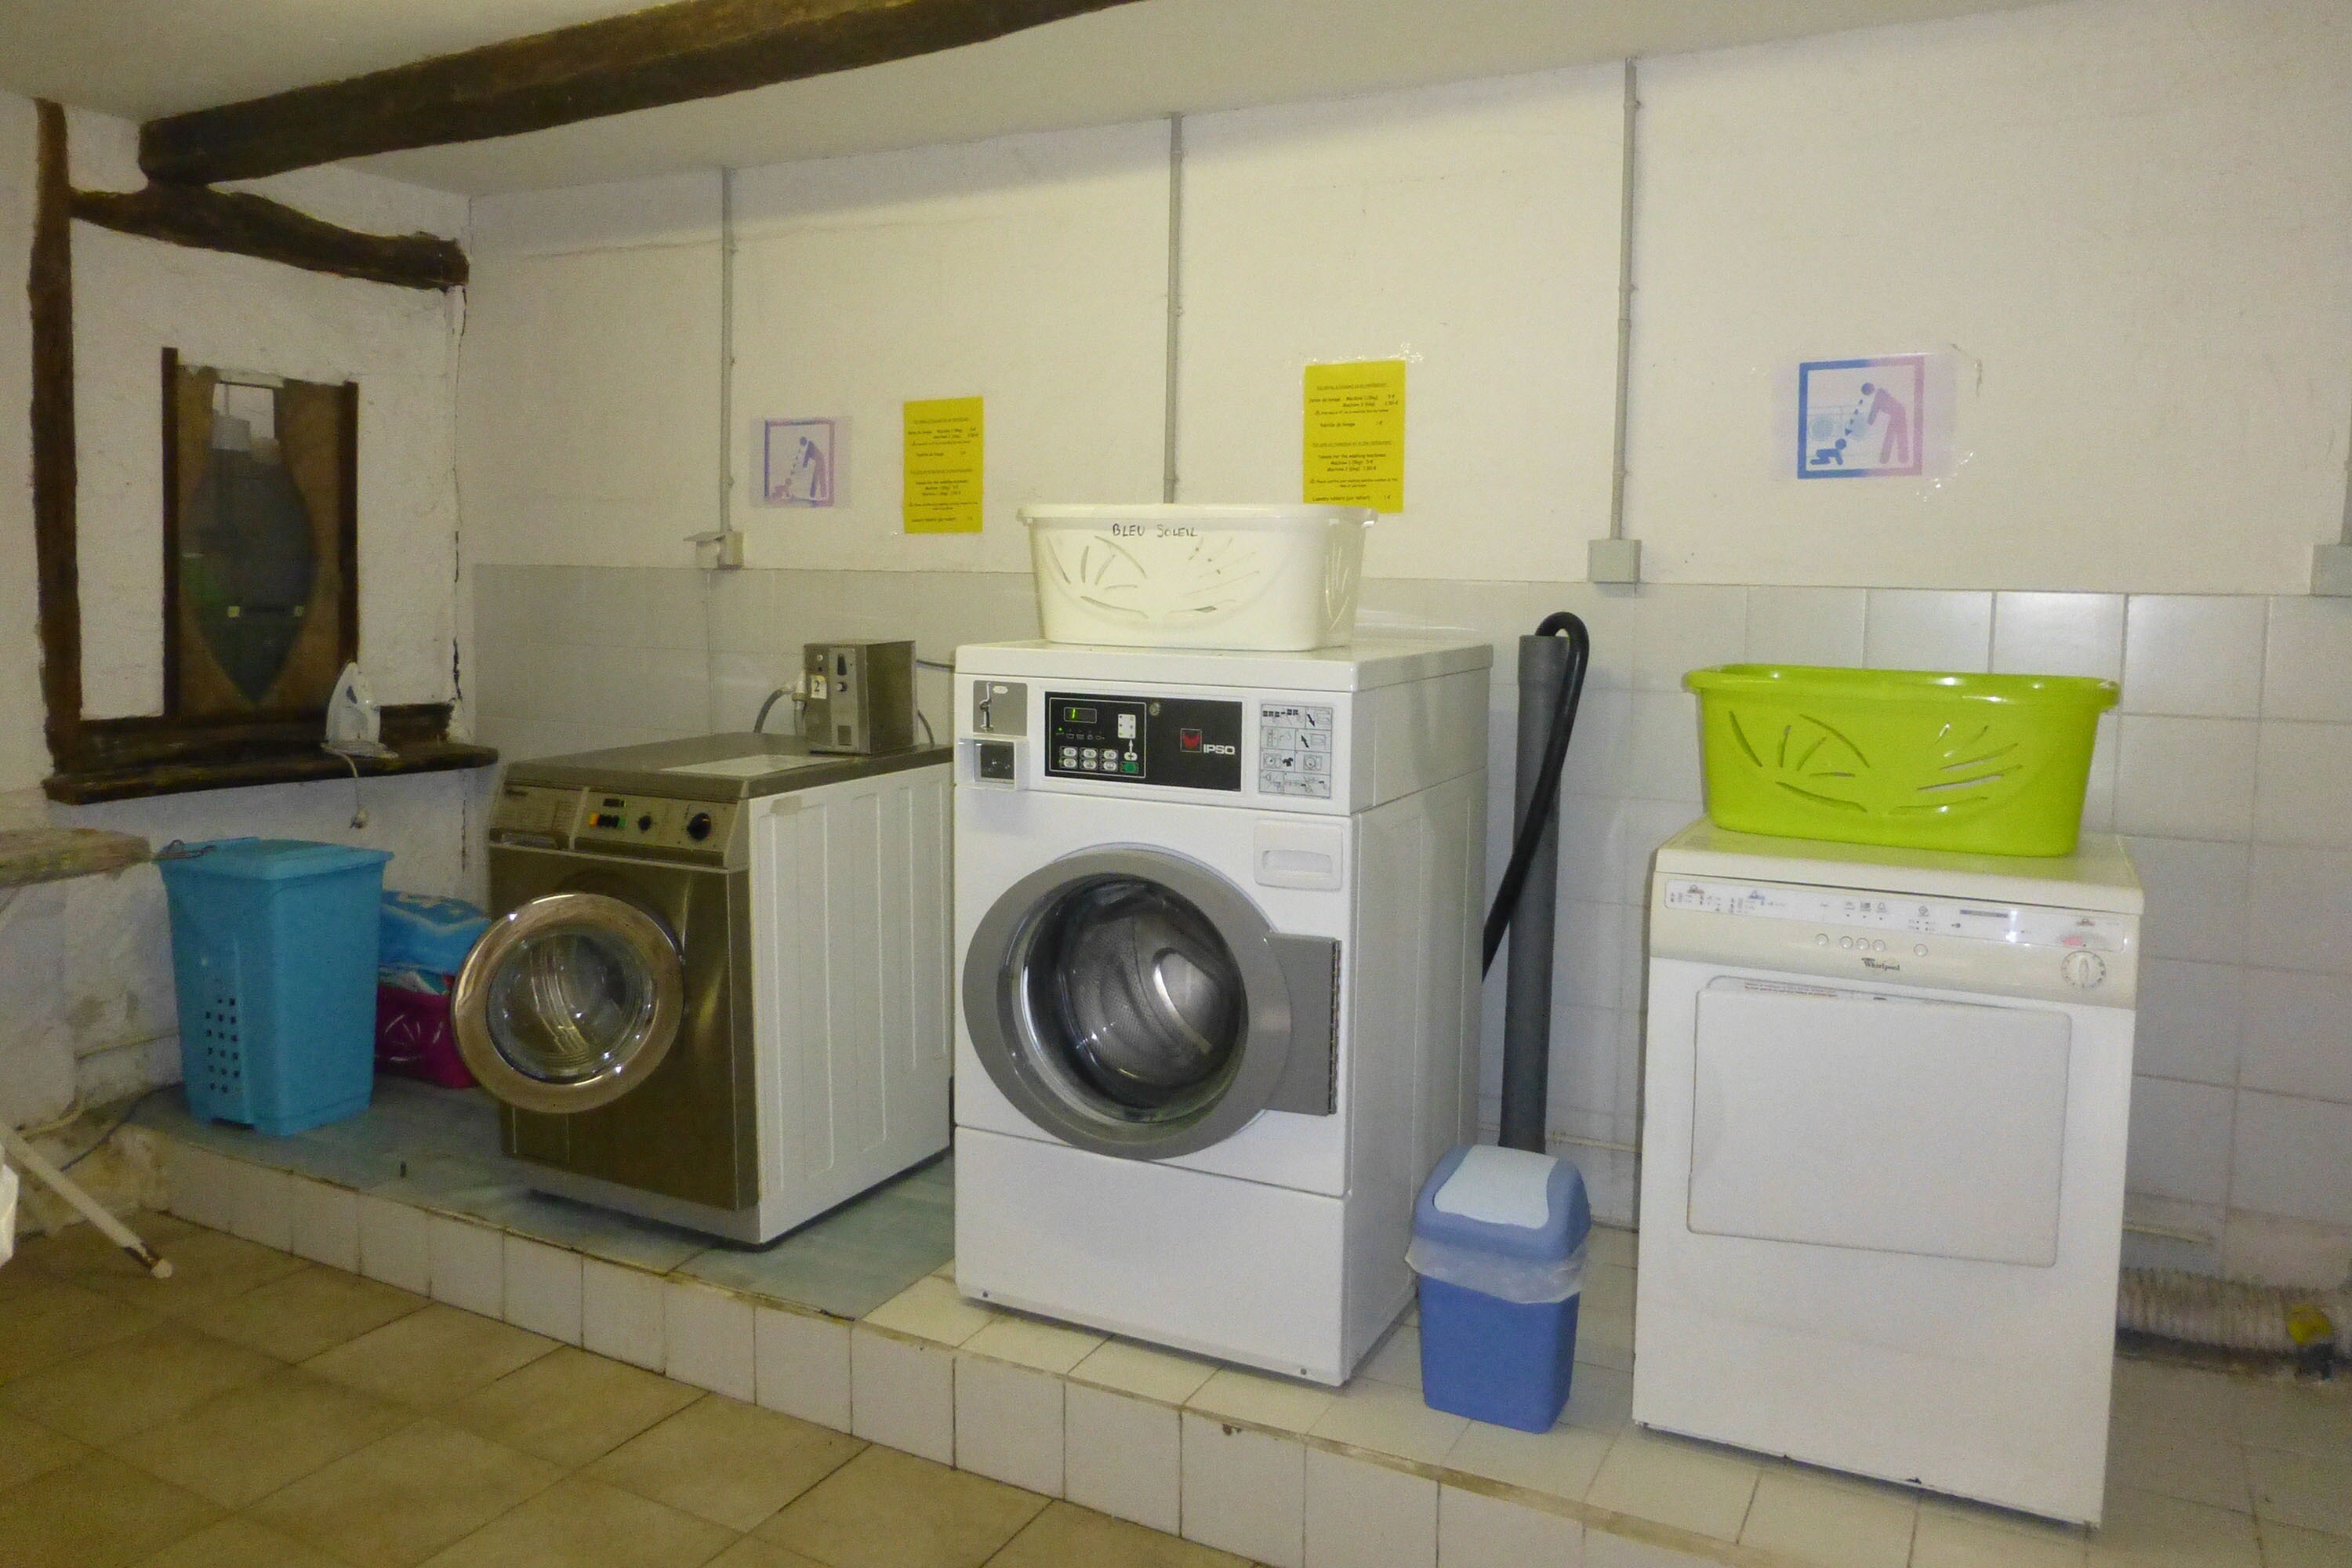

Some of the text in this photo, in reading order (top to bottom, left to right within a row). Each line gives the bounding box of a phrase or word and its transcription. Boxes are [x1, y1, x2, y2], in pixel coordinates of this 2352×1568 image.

[1112, 523, 1198, 538] BLEU SOLEIL
[814, 680, 820, 693] 2
[1203, 743, 1236, 755] IPSO
